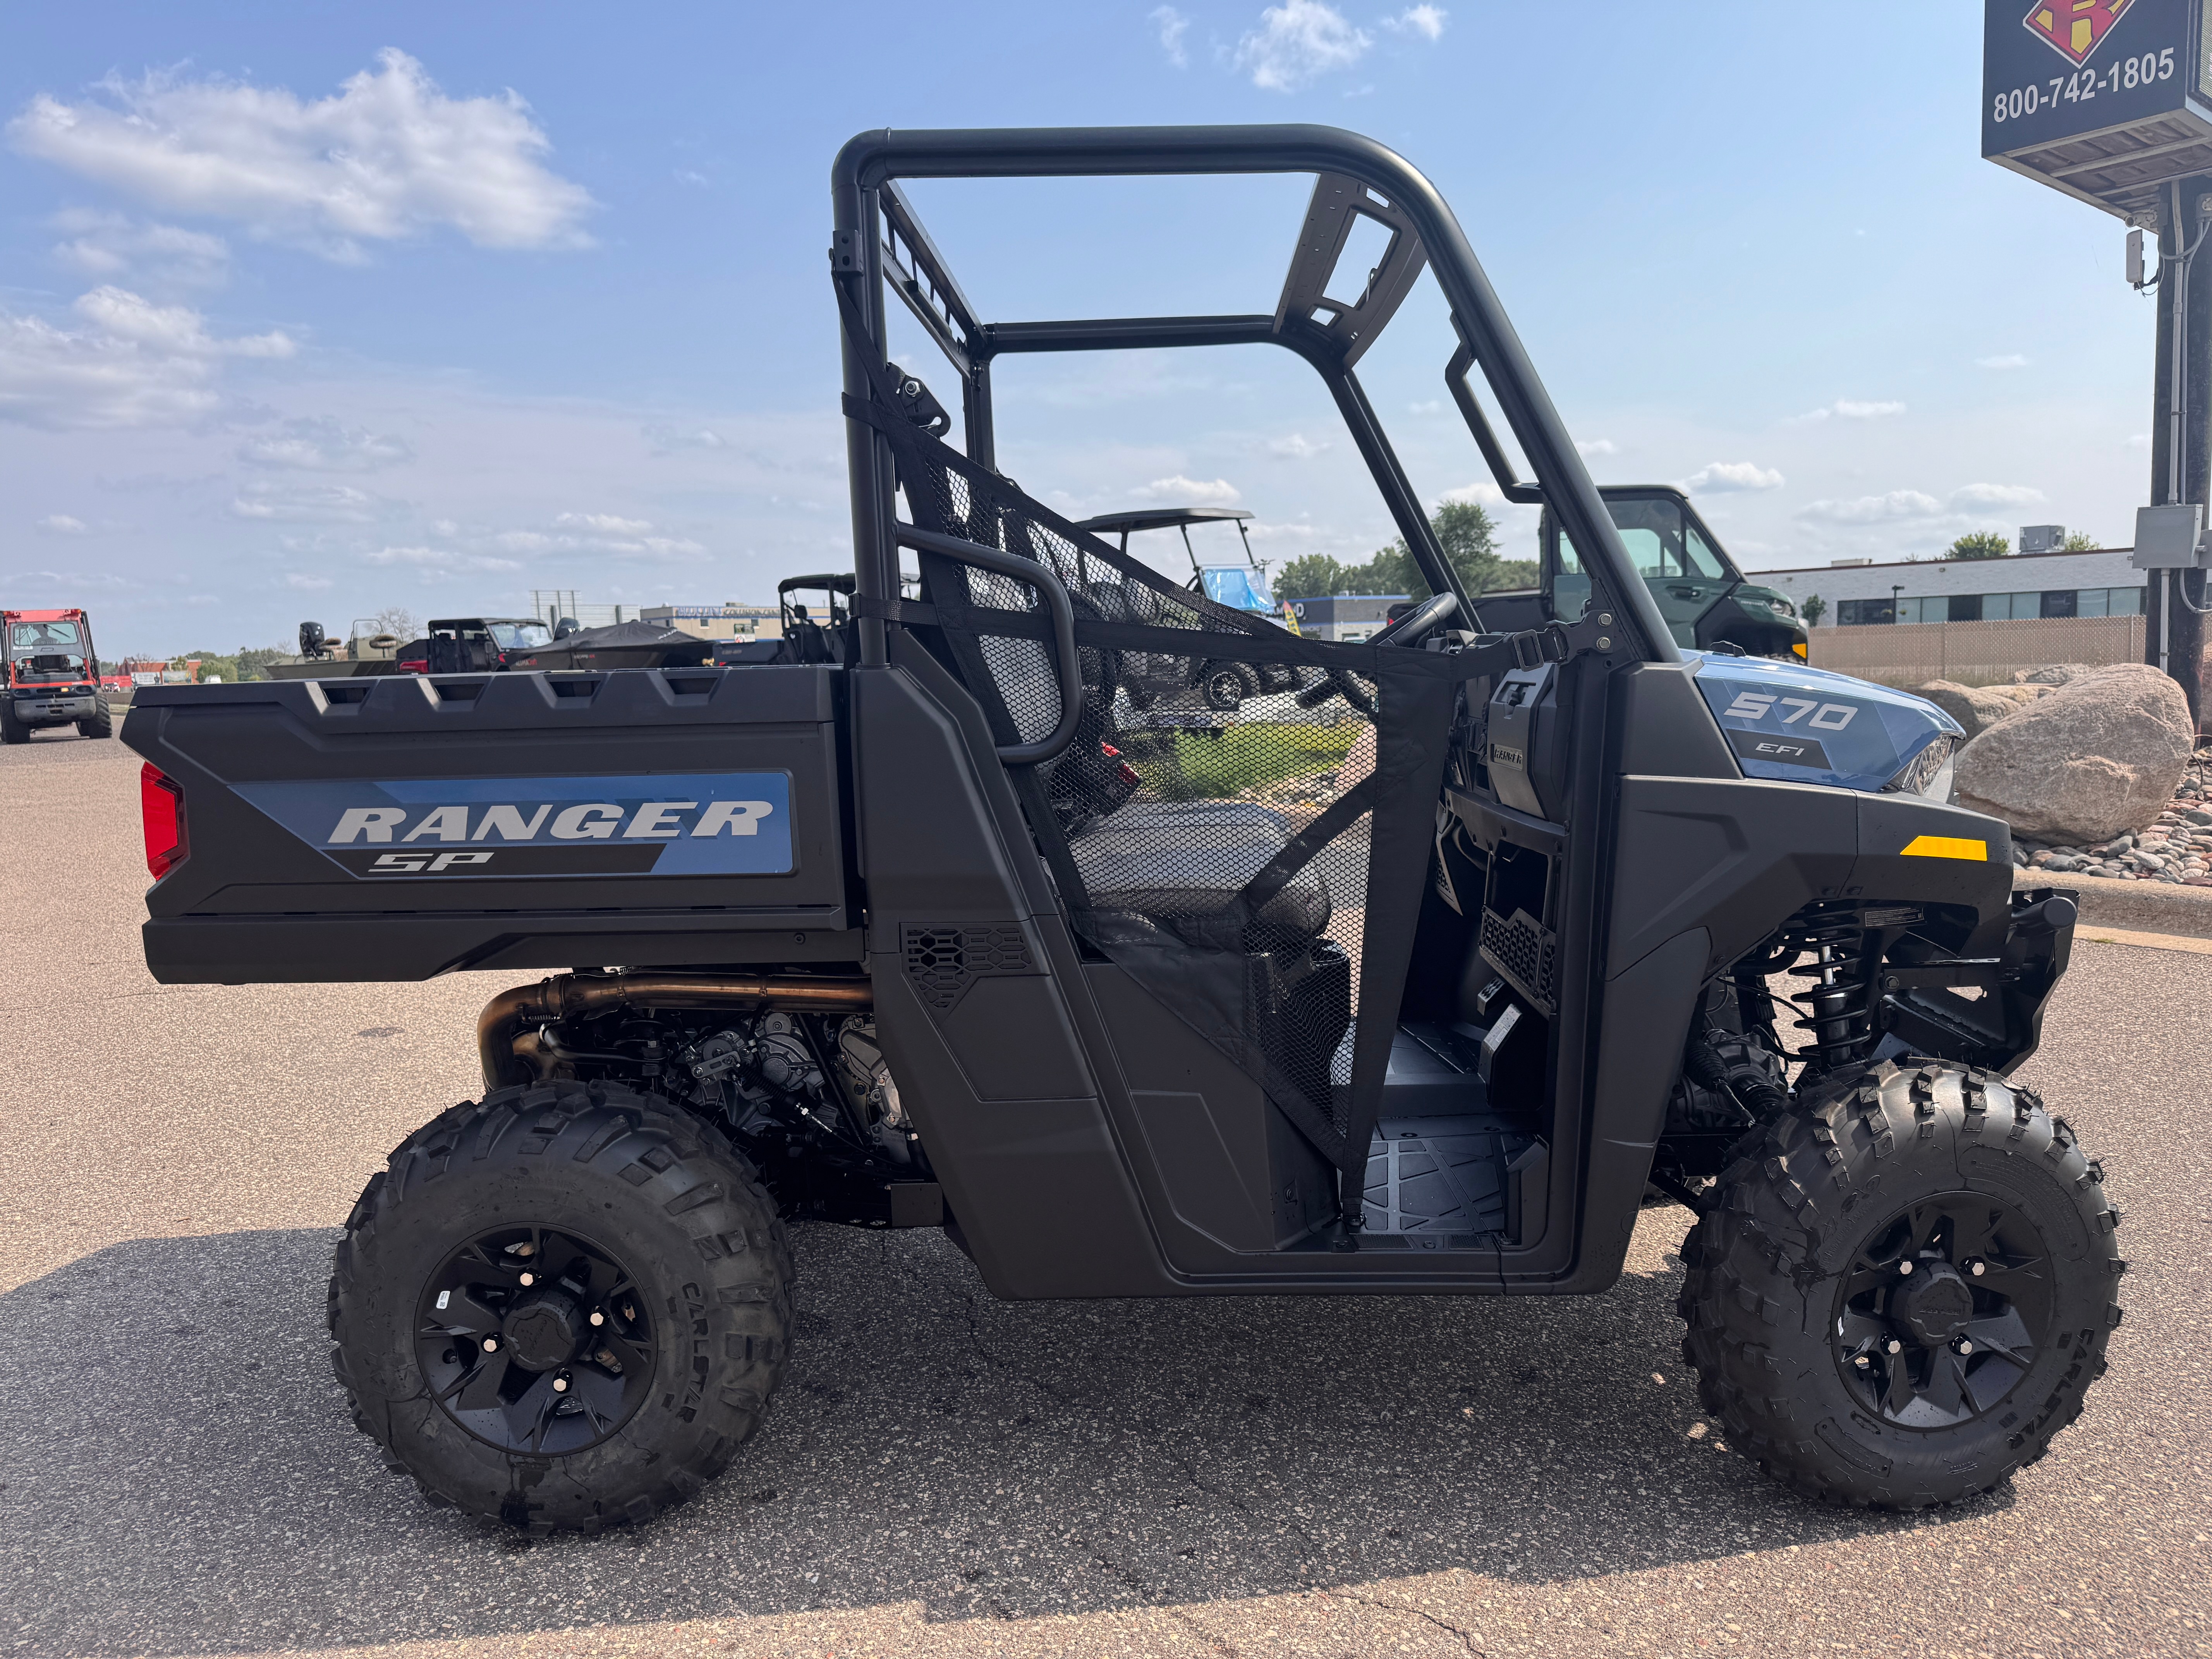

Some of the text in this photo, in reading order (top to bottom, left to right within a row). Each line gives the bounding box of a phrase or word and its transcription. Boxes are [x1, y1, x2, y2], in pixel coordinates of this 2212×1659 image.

[1994, 47, 2174, 123] 800-742-1805
[1724, 692, 1858, 731] 570
[1494, 749, 1522, 764] RANGER
[1755, 742, 1805, 756] EFI
[327, 800, 774, 843] RANGER
[368, 852, 495, 872] SP
[675, 1282, 709, 1424] CARLSTAR
[2007, 1327, 2095, 1450] CARLSTAR
